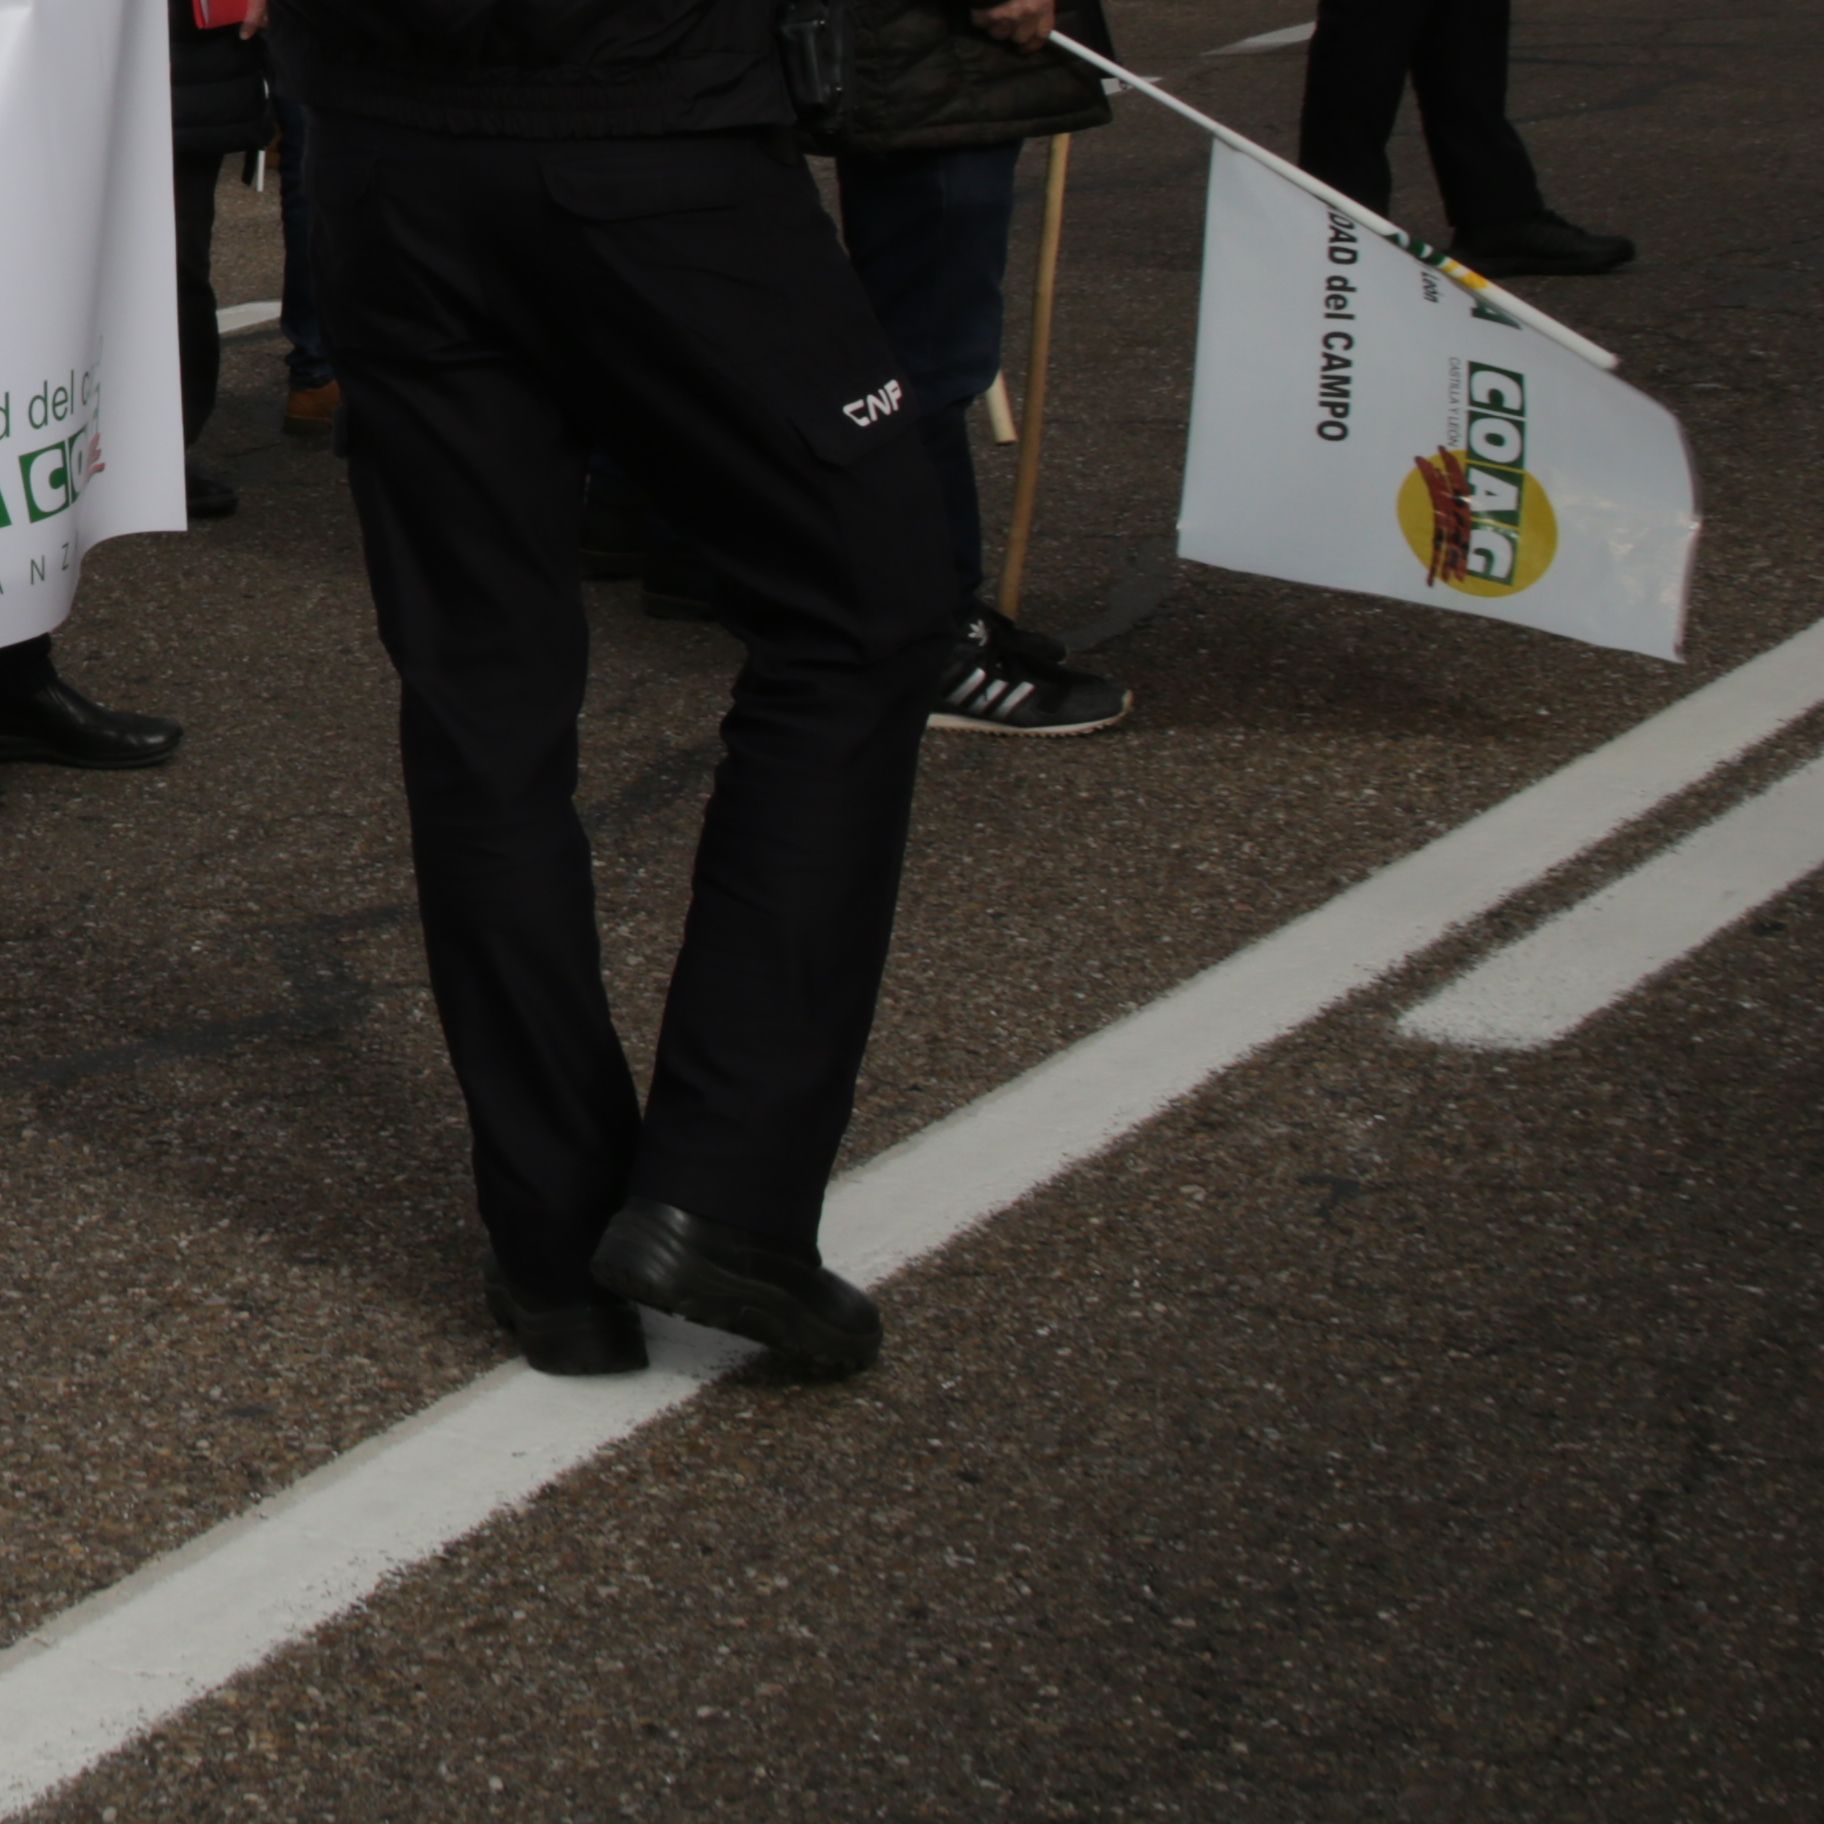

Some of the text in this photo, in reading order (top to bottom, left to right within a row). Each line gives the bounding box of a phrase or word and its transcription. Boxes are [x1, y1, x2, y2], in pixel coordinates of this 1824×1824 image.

[1323, 274, 1357, 321] del
[28, 369, 75, 430] del
[842, 379, 903, 428] CNP
[1316, 331, 1355, 443] CAMPO
[1464, 360, 1525, 587] COAG
